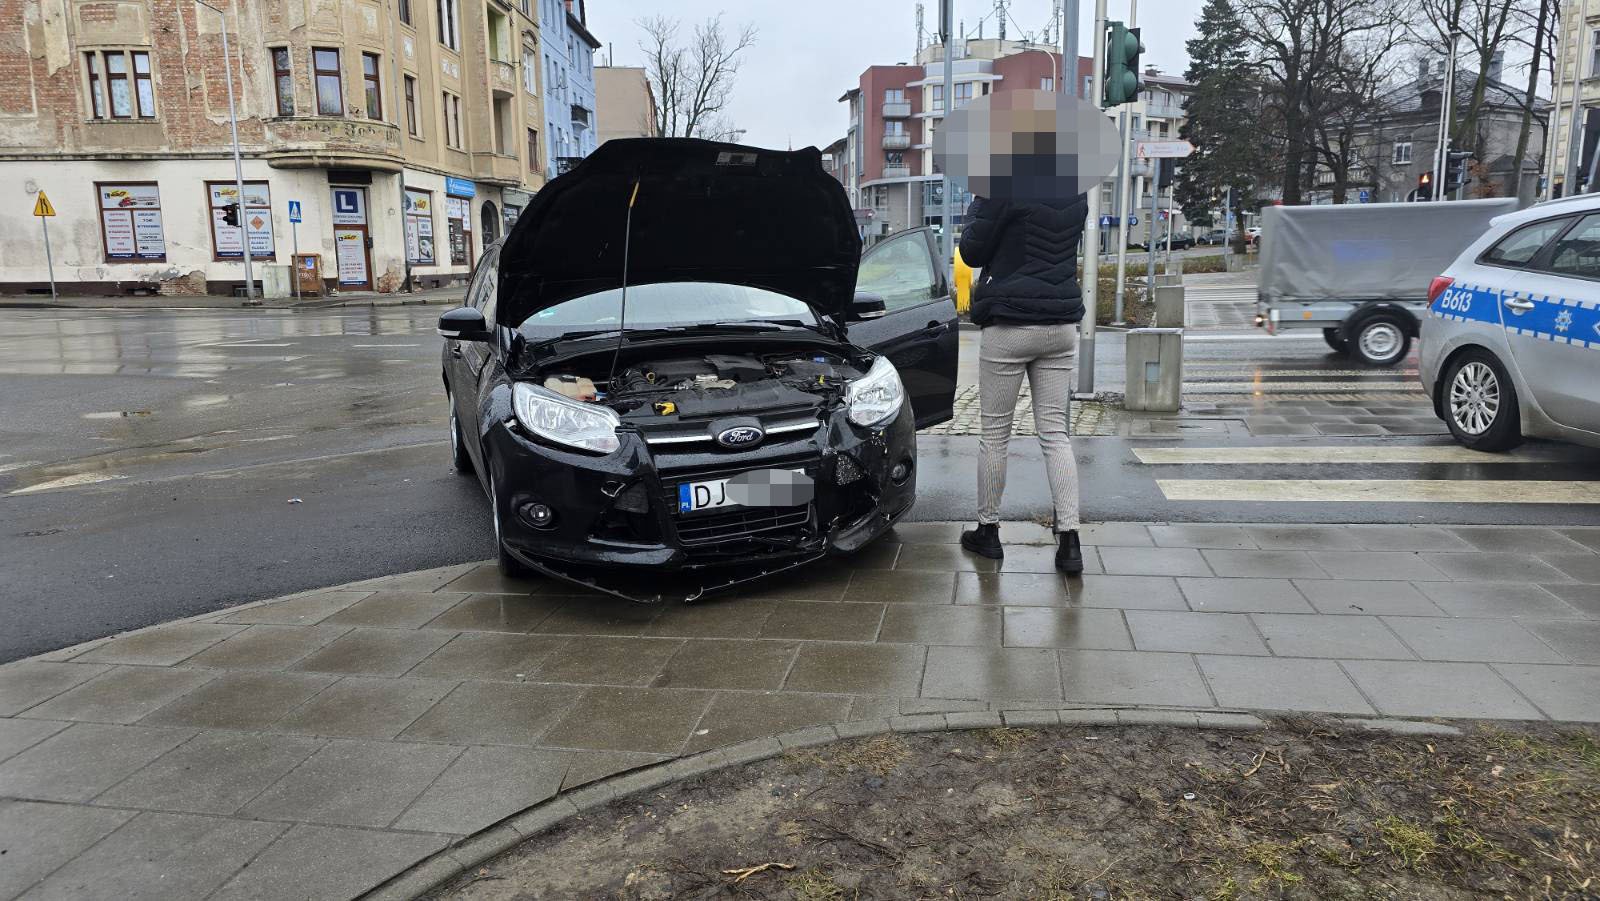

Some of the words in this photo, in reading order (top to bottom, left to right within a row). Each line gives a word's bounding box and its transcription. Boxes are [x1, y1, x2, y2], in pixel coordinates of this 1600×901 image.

[340, 194, 354, 210] L
[1441, 289, 1473, 313] B613
[729, 430, 754, 443] Ford
